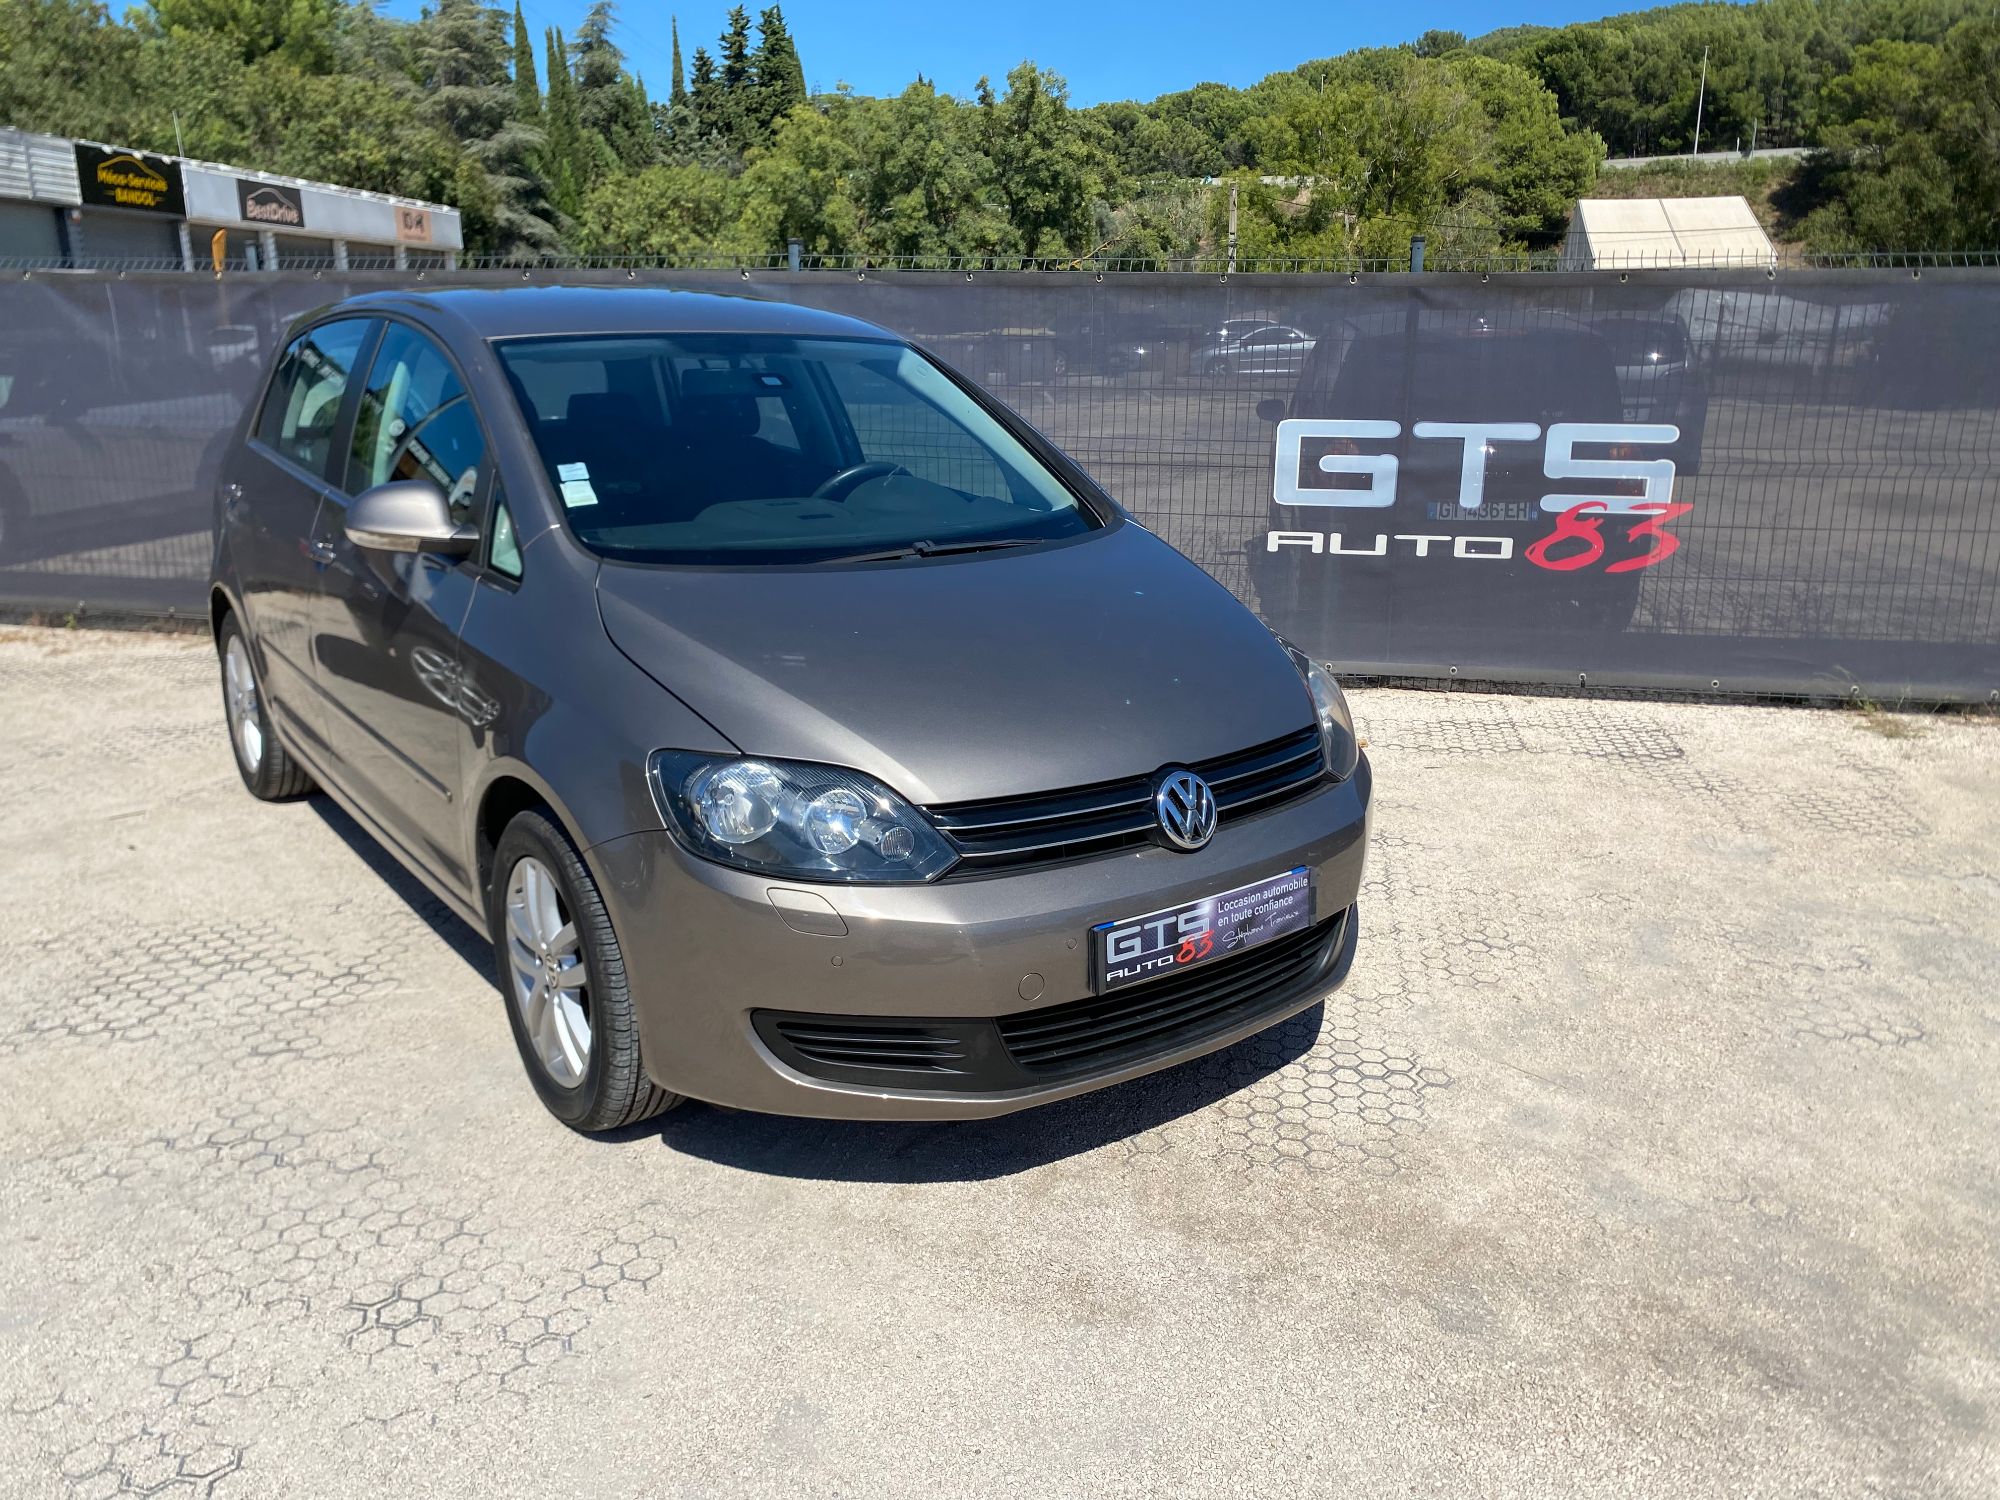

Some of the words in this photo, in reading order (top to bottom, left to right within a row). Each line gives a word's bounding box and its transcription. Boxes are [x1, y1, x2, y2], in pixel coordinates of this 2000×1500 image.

[1273, 419, 1680, 514] GTS
[1267, 531, 1514, 559] AUTO
[1524, 501, 1693, 573] 83
[1217, 916, 1229, 927] en
[1231, 908, 1253, 923] toute
[1254, 895, 1294, 916] confiance
[1218, 892, 1261, 914] L'occasion
[1262, 877, 1308, 899] automobile
[1106, 907, 1210, 964] GTS
[1106, 955, 1174, 981] AUTO
[1175, 930, 1215, 964] 83
